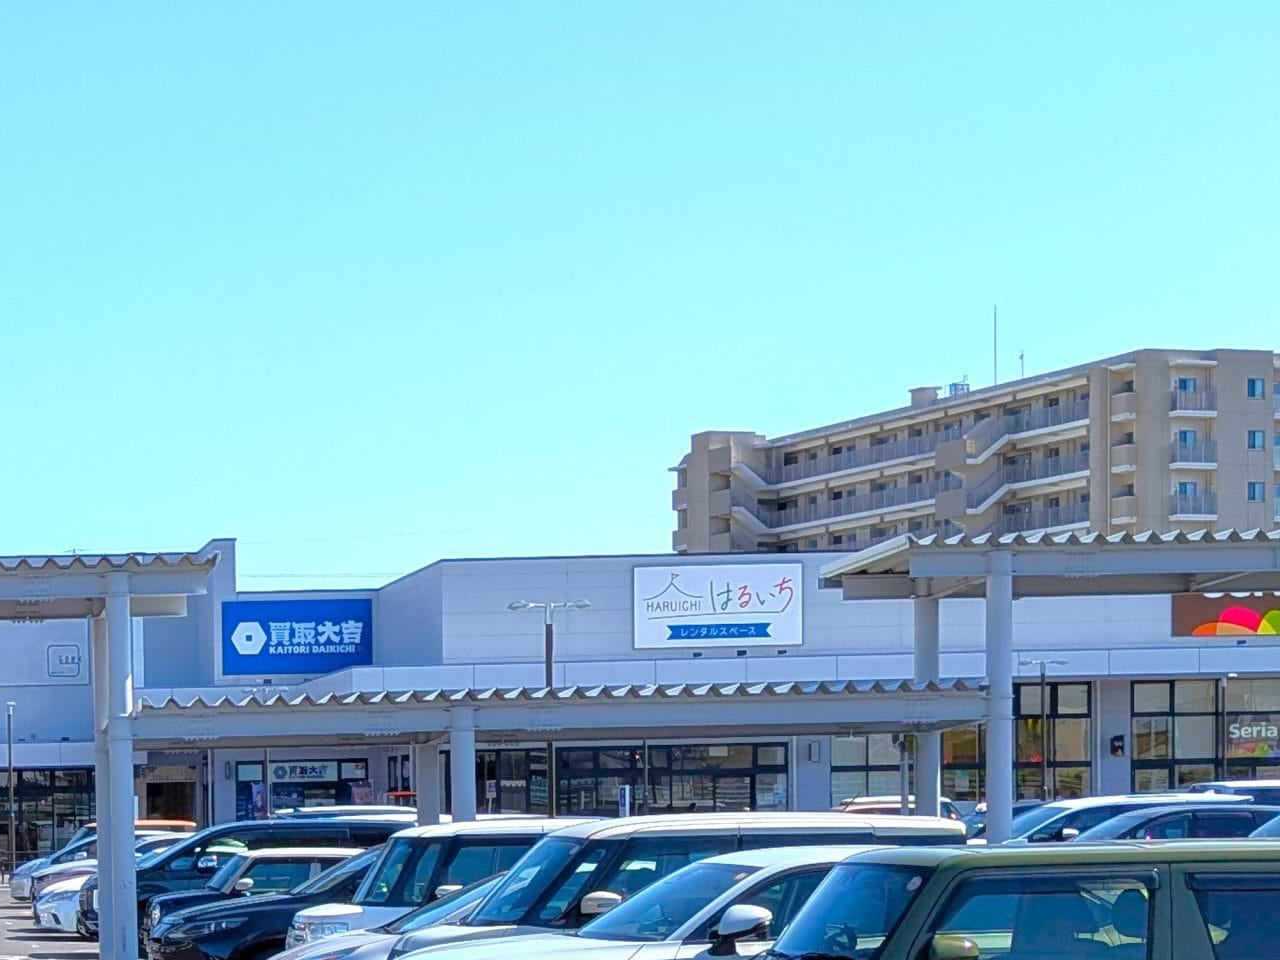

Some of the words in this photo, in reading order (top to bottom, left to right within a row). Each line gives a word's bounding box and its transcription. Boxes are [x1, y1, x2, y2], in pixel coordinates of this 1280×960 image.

[710, 577, 793, 612] はるいち
[646, 600, 701, 612] HARUICHI
[268, 620, 363, 645] 買取大吉
[680, 626, 756, 636] レンタルスペース
[269, 645, 309, 654] KAITORI
[312, 644, 356, 653] DAIKICHI
[1228, 722, 1278, 738] Seria
